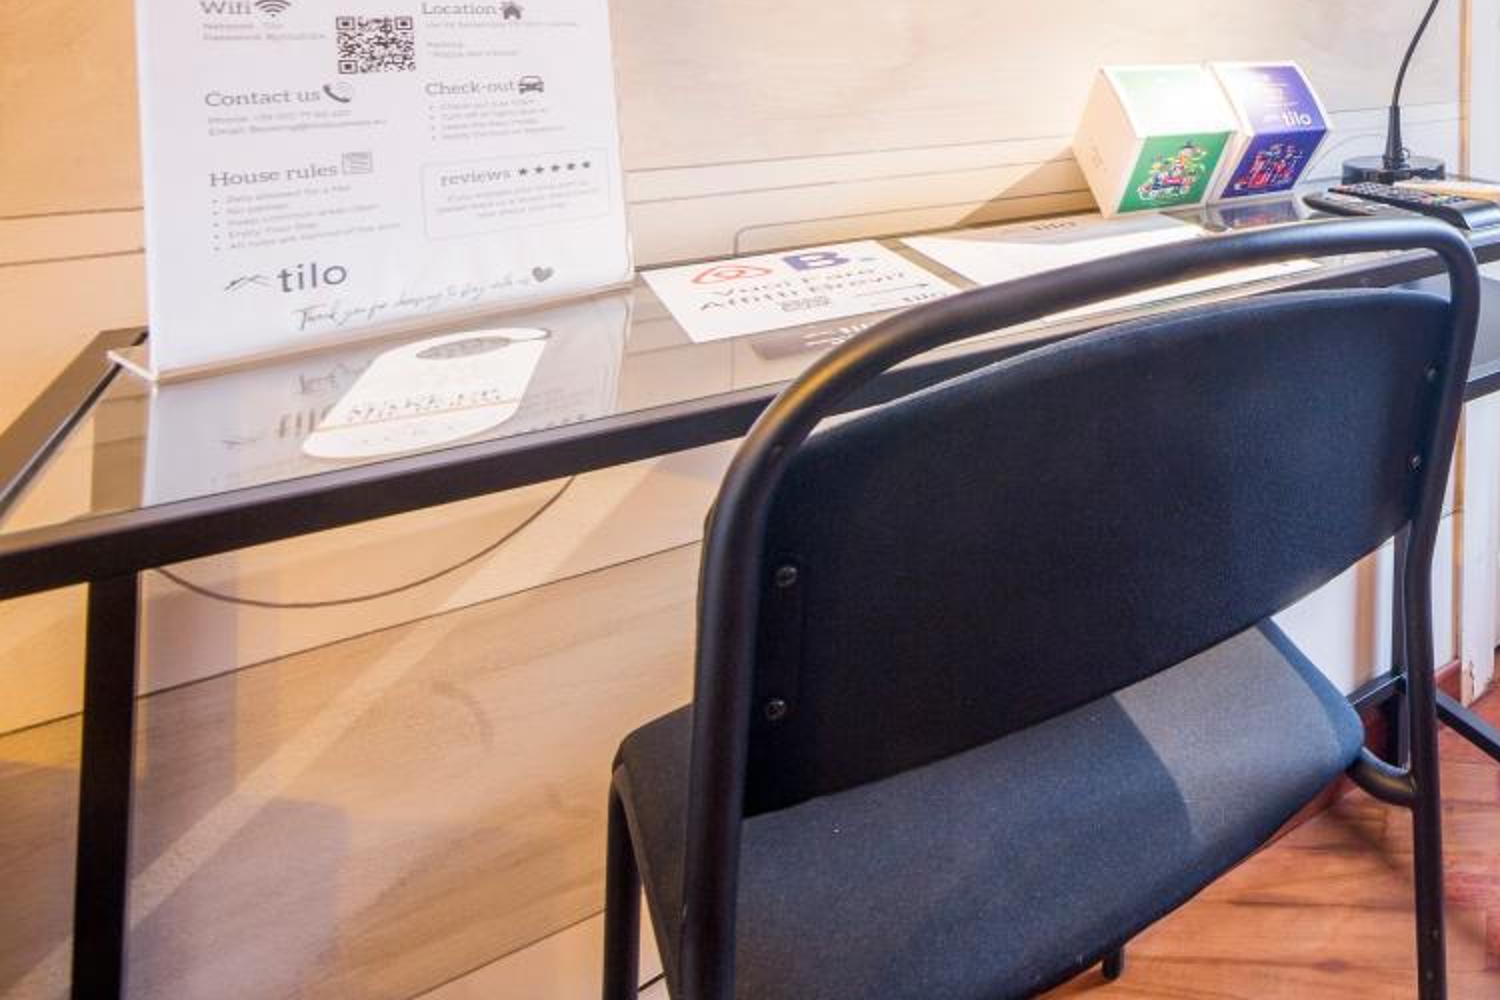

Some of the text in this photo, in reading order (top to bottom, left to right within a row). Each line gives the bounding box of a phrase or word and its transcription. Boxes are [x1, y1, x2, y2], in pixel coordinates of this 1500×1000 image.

[199, 0, 253, 16] Wifi
[421, 2, 497, 15] Location
[425, 80, 515, 96] Check-out
[204, 89, 321, 107] Contact us
[1282, 111, 1312, 126] tilo
[209, 164, 339, 187] House rules
[440, 169, 512, 187] reviews
[277, 262, 348, 293] tilo
